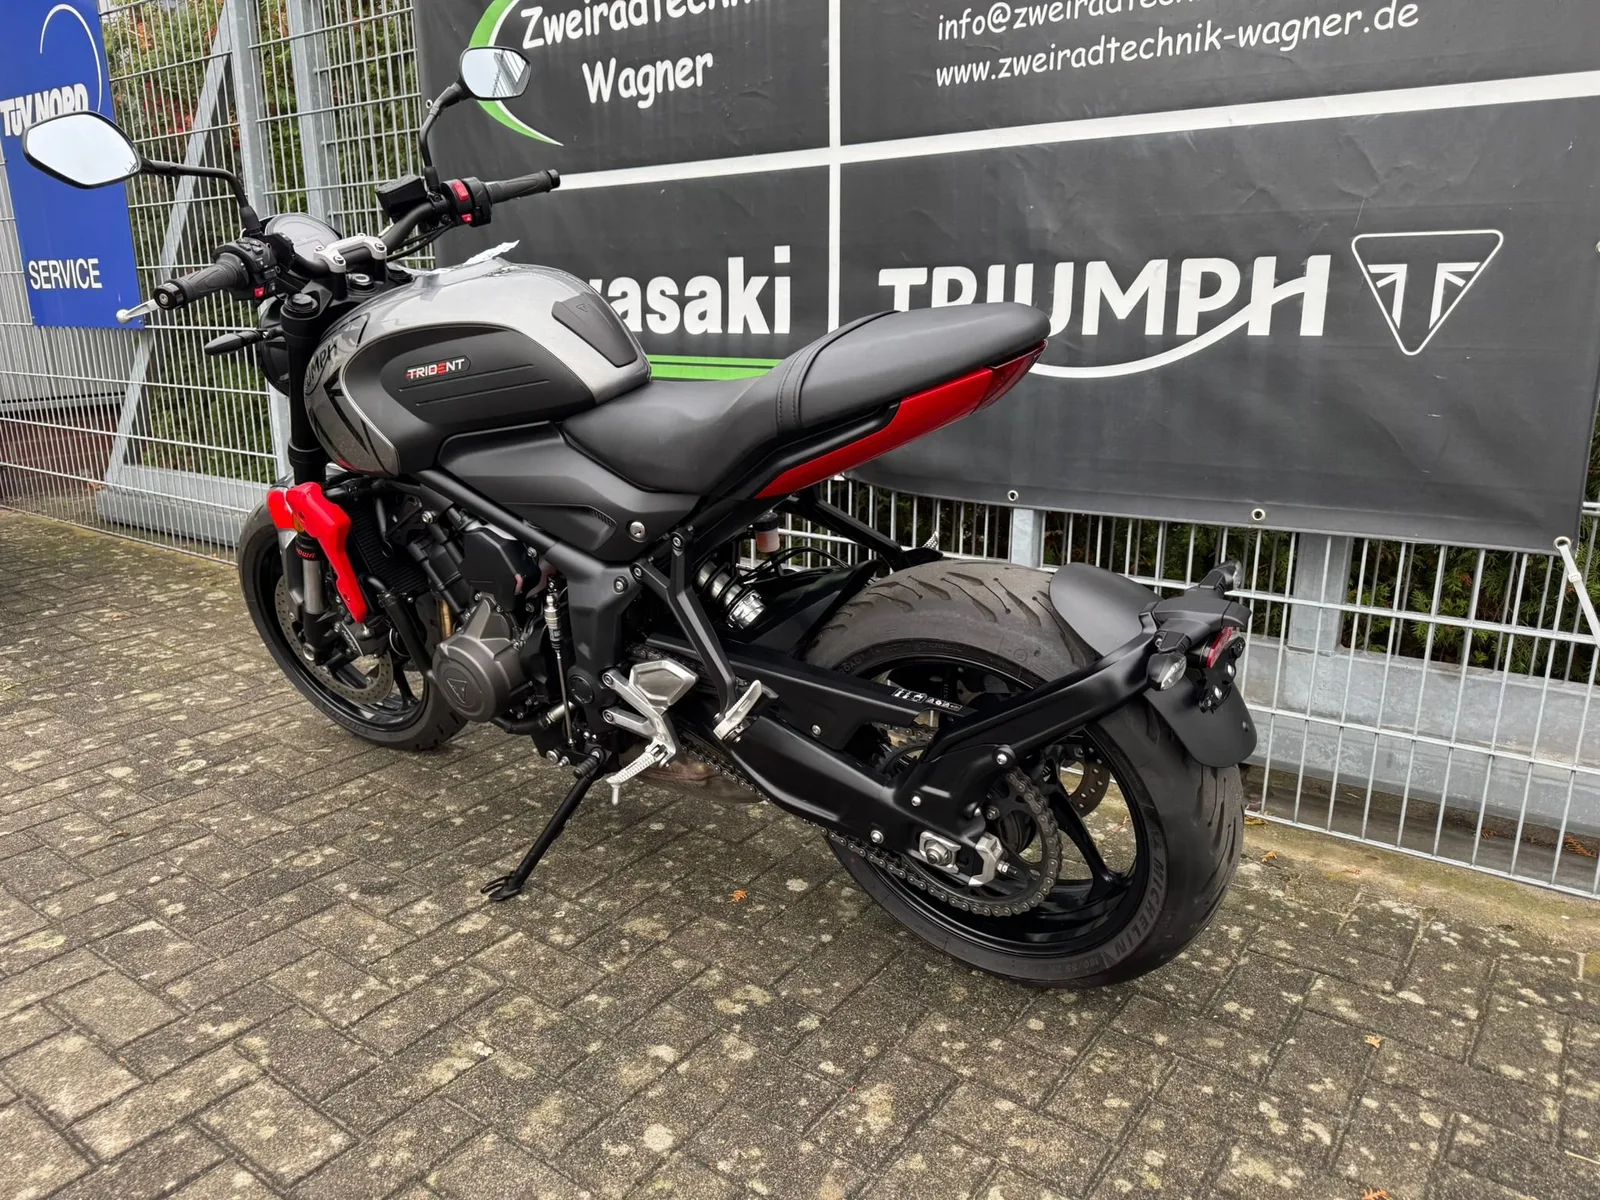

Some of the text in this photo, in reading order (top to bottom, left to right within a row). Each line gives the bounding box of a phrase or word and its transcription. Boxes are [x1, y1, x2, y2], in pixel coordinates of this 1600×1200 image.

[936, 0, 1419, 87] www.zweiradtechnik-wagner.de
[34, 83, 89, 122] NORD
[582, 52, 714, 109] Wagner
[28, 258, 103, 290] SERVICE
[588, 245, 791, 335] asaki
[406, 358, 465, 380] TRIDENT
[1113, 857, 1165, 957] MICHELIN
